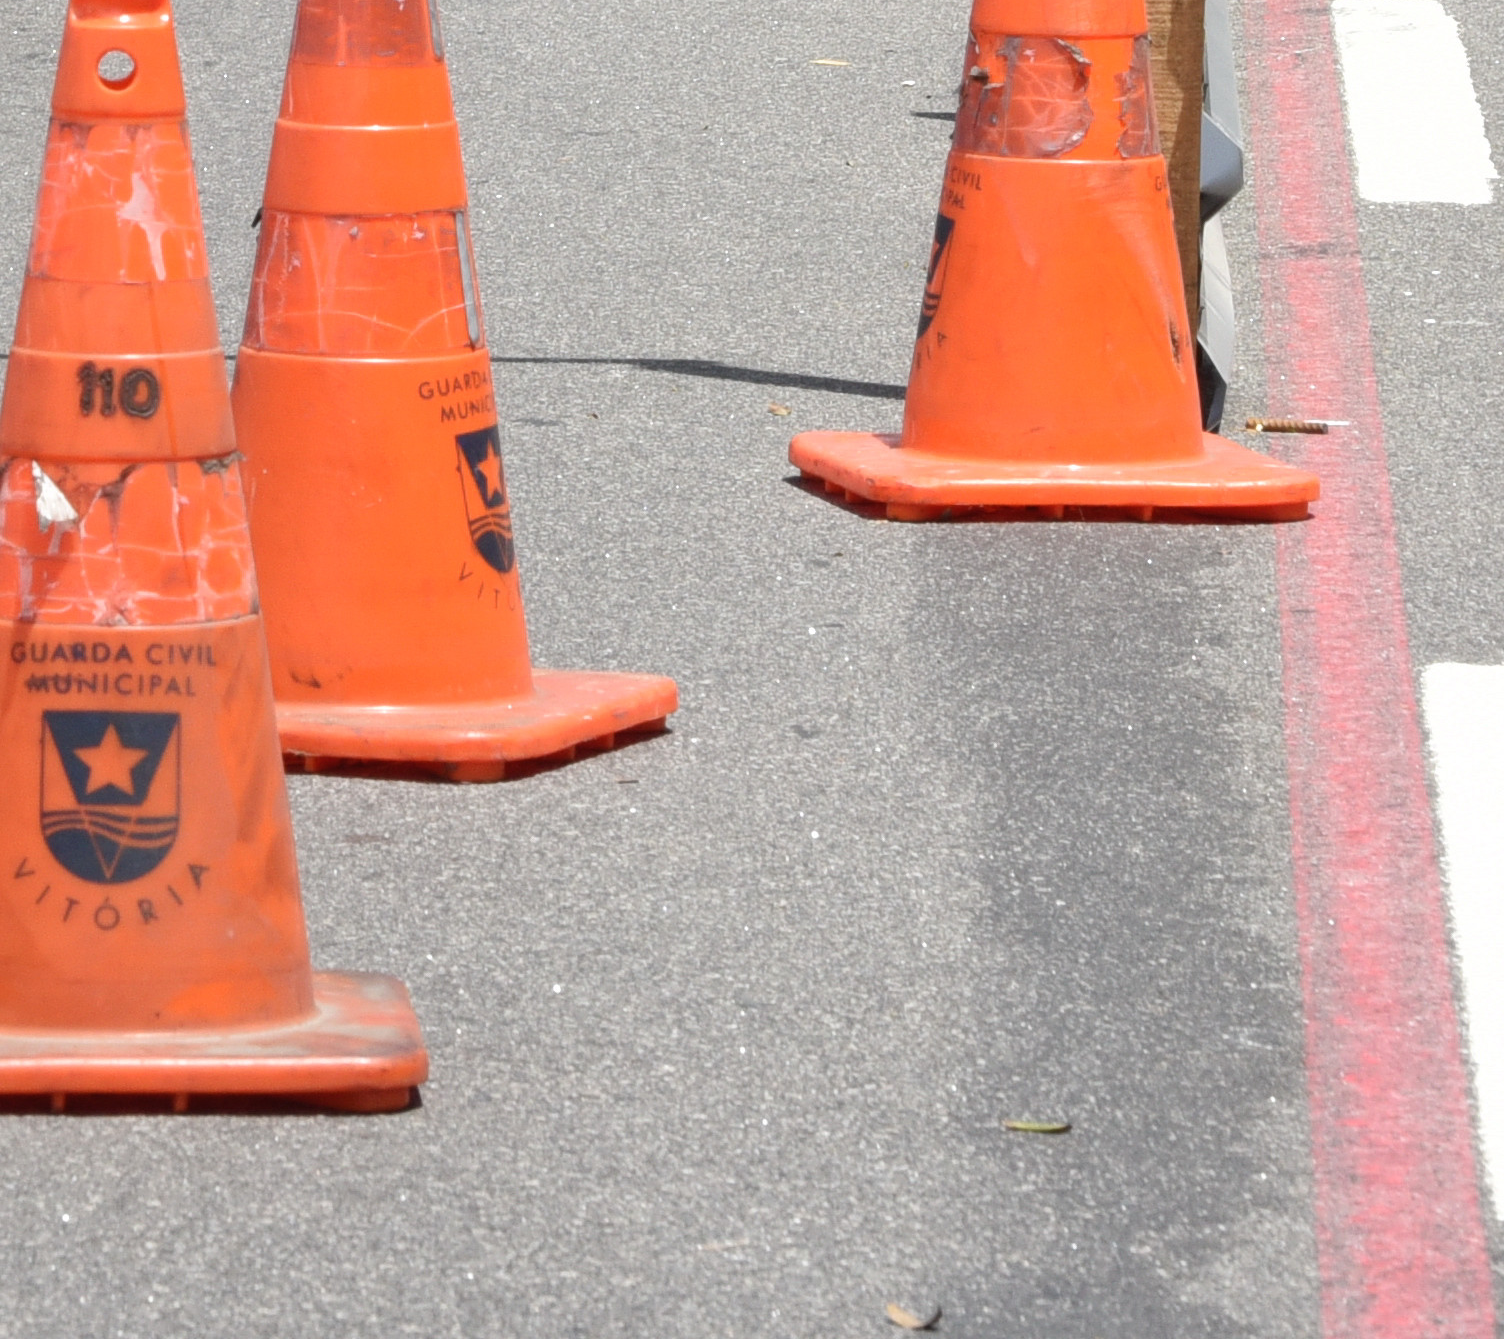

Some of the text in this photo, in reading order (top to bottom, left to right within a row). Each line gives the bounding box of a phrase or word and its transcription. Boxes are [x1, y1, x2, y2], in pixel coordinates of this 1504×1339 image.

[951, 166, 982, 191] CIVIL
[77, 360, 161, 419] 110
[441, 395, 491, 423] MUNIC
[11, 641, 217, 667] GUARDA CIVIL
[26, 673, 197, 697] MUNICIPAL
